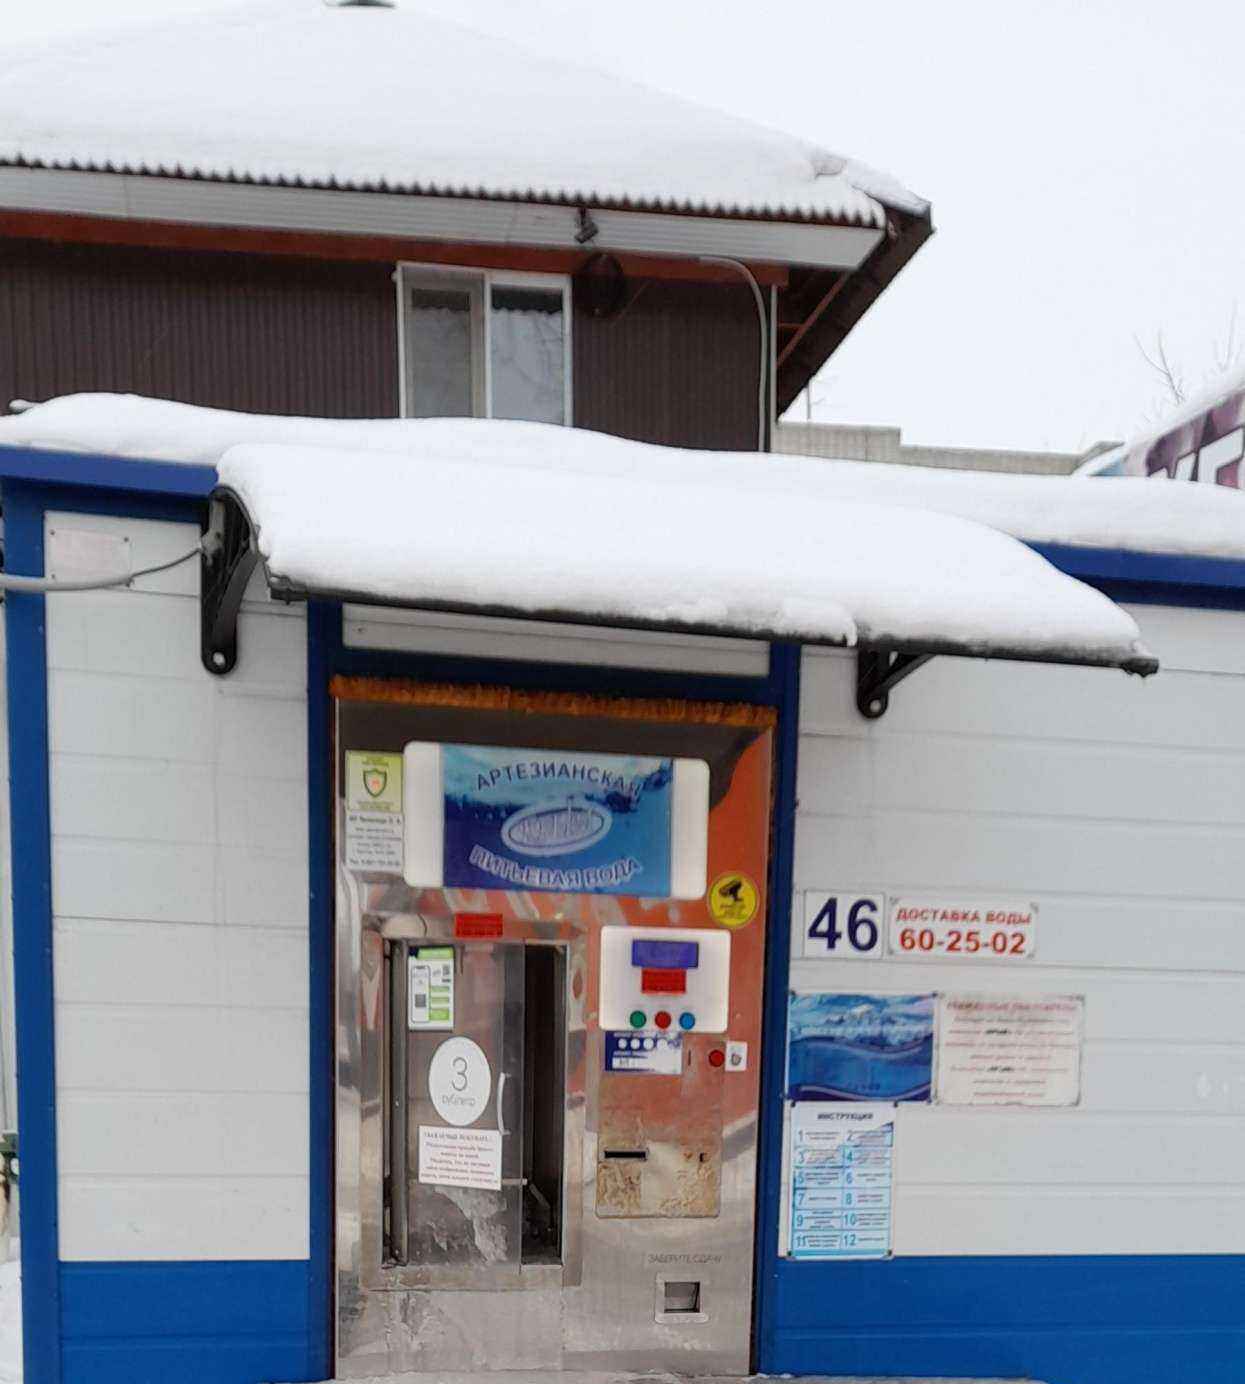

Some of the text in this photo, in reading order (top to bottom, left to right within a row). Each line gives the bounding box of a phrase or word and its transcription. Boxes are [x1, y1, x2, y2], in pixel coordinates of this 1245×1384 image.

[476, 760, 644, 801] АРТЕЗИАНСКАЯ
[469, 844, 644, 890] ПИТЬЕВАЯ ВОДА
[896, 907, 1032, 926] ДОСТАВКА ВОДЫ
[807, 897, 879, 952] 46
[899, 929, 1027, 955] 60-25-02
[452, 1057, 468, 1092] 3
[798, 1172, 805, 1184] 5
[846, 1172, 853, 1184] 6
[798, 1194, 805, 1206] 7
[796, 1215, 804, 1227] 9
[843, 1213, 857, 1226] 10
[796, 1236, 806, 1247] 11
[843, 1235, 857, 1247] 12
